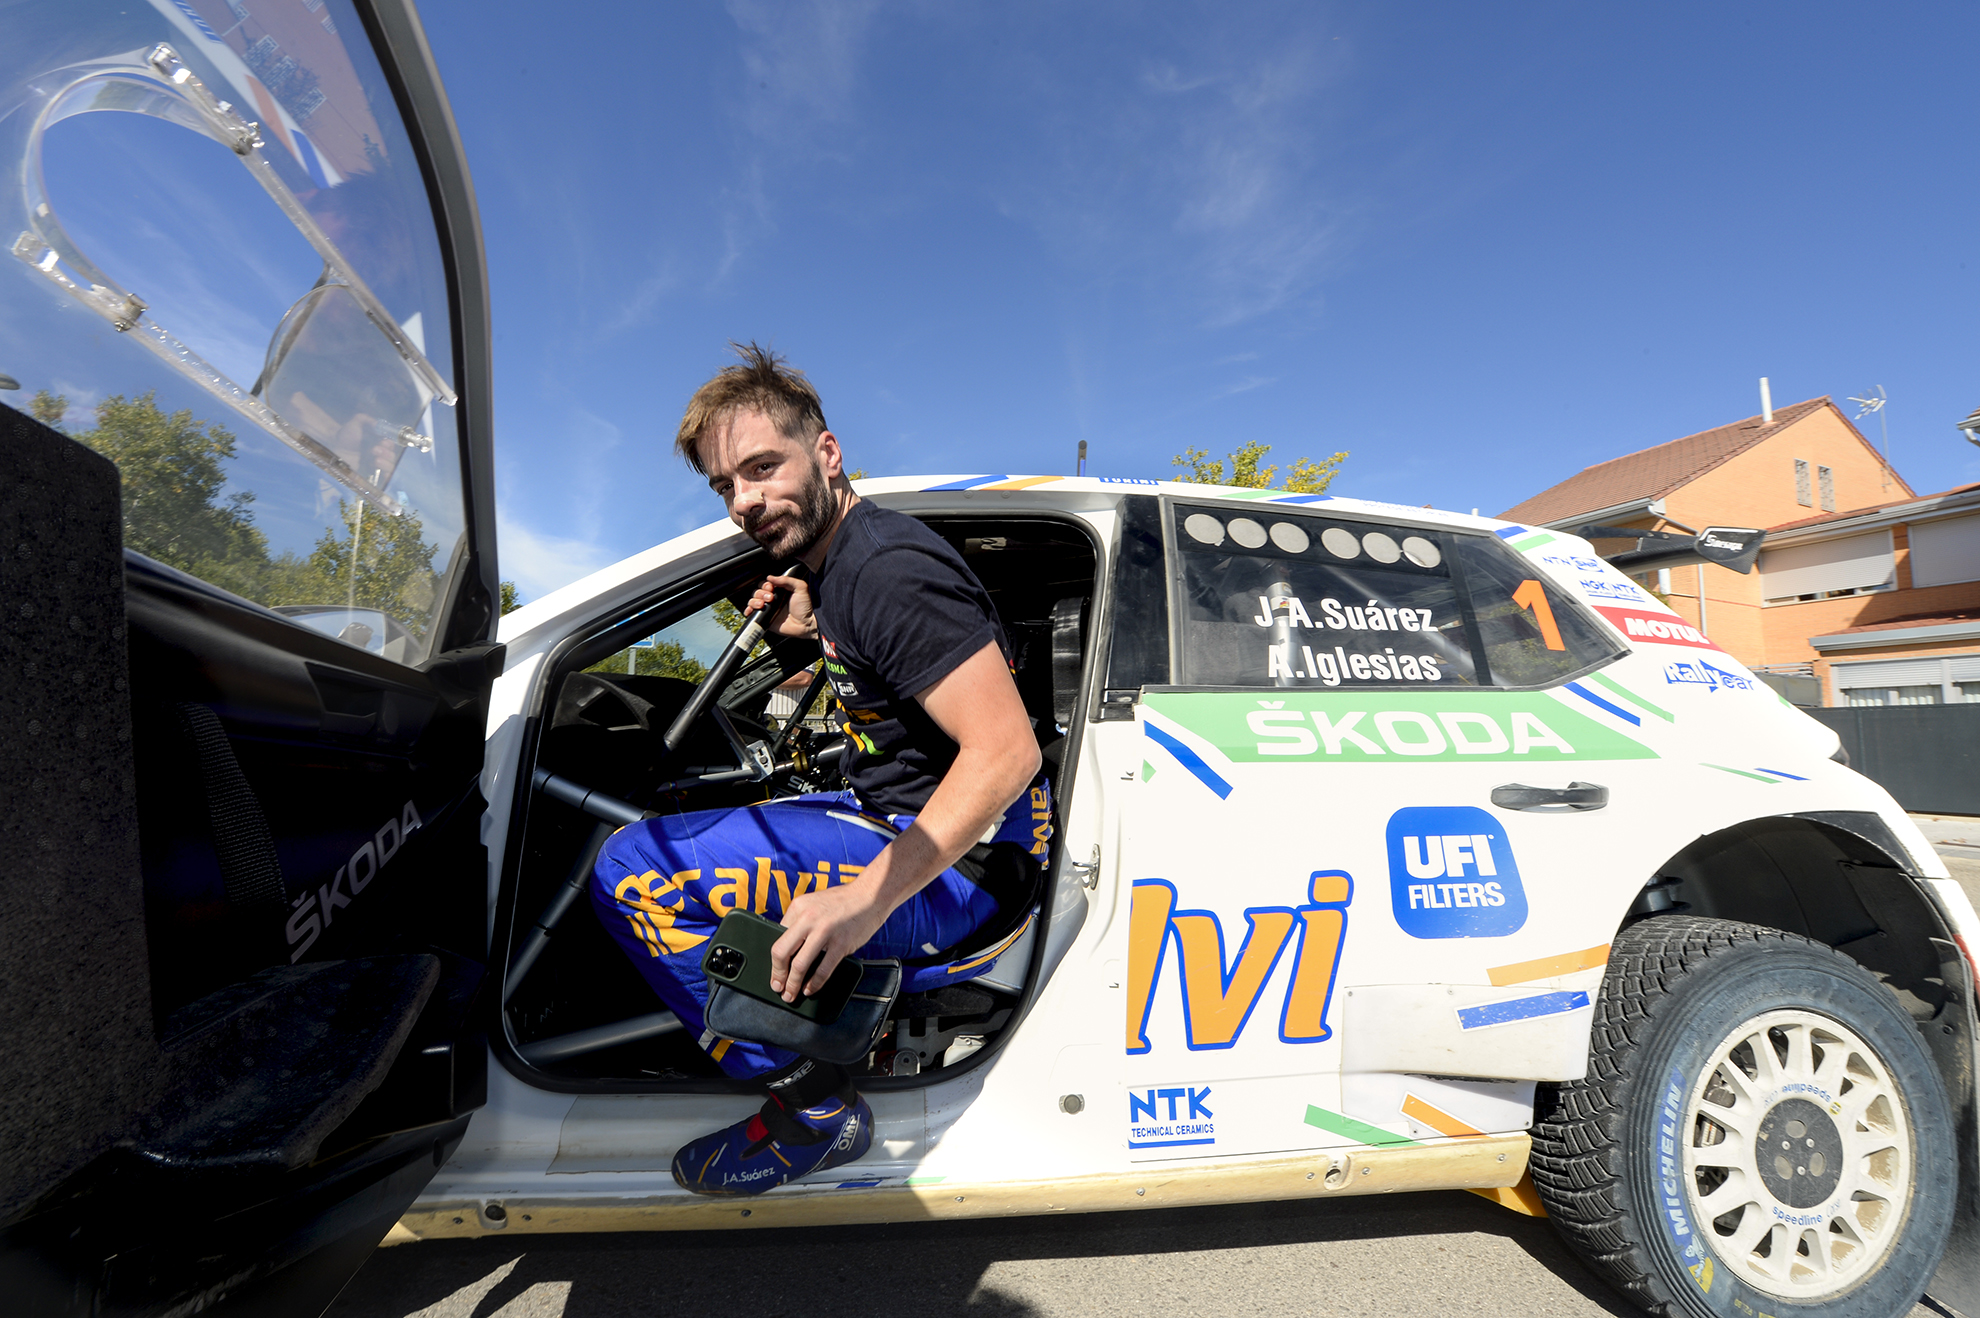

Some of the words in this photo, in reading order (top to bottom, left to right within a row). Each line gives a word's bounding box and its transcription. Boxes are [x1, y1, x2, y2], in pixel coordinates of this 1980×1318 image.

[1254, 596, 1438, 632] J.A.Suárez
[1511, 580, 1566, 651] 1
[1624, 617, 1711, 645] MOTUL
[1268, 644, 1443, 686] A.Iglesias
[1245, 700, 1576, 756] ŠKODA
[1403, 834, 1497, 879] UFI
[285, 800, 423, 964] ŠKODA
[1408, 882, 1506, 909] FILTERS
[1129, 1086, 1214, 1123] NTK
[838, 1114, 857, 1151] OMP
[1131, 1126, 1174, 1138] TECHNICAL
[1176, 1123, 1215, 1135] CERAMICS
[722, 1166, 776, 1186] J.A.Suárez
[1661, 1082, 1690, 1236] MICHELIN
[1772, 1206, 1823, 1226] speedline
